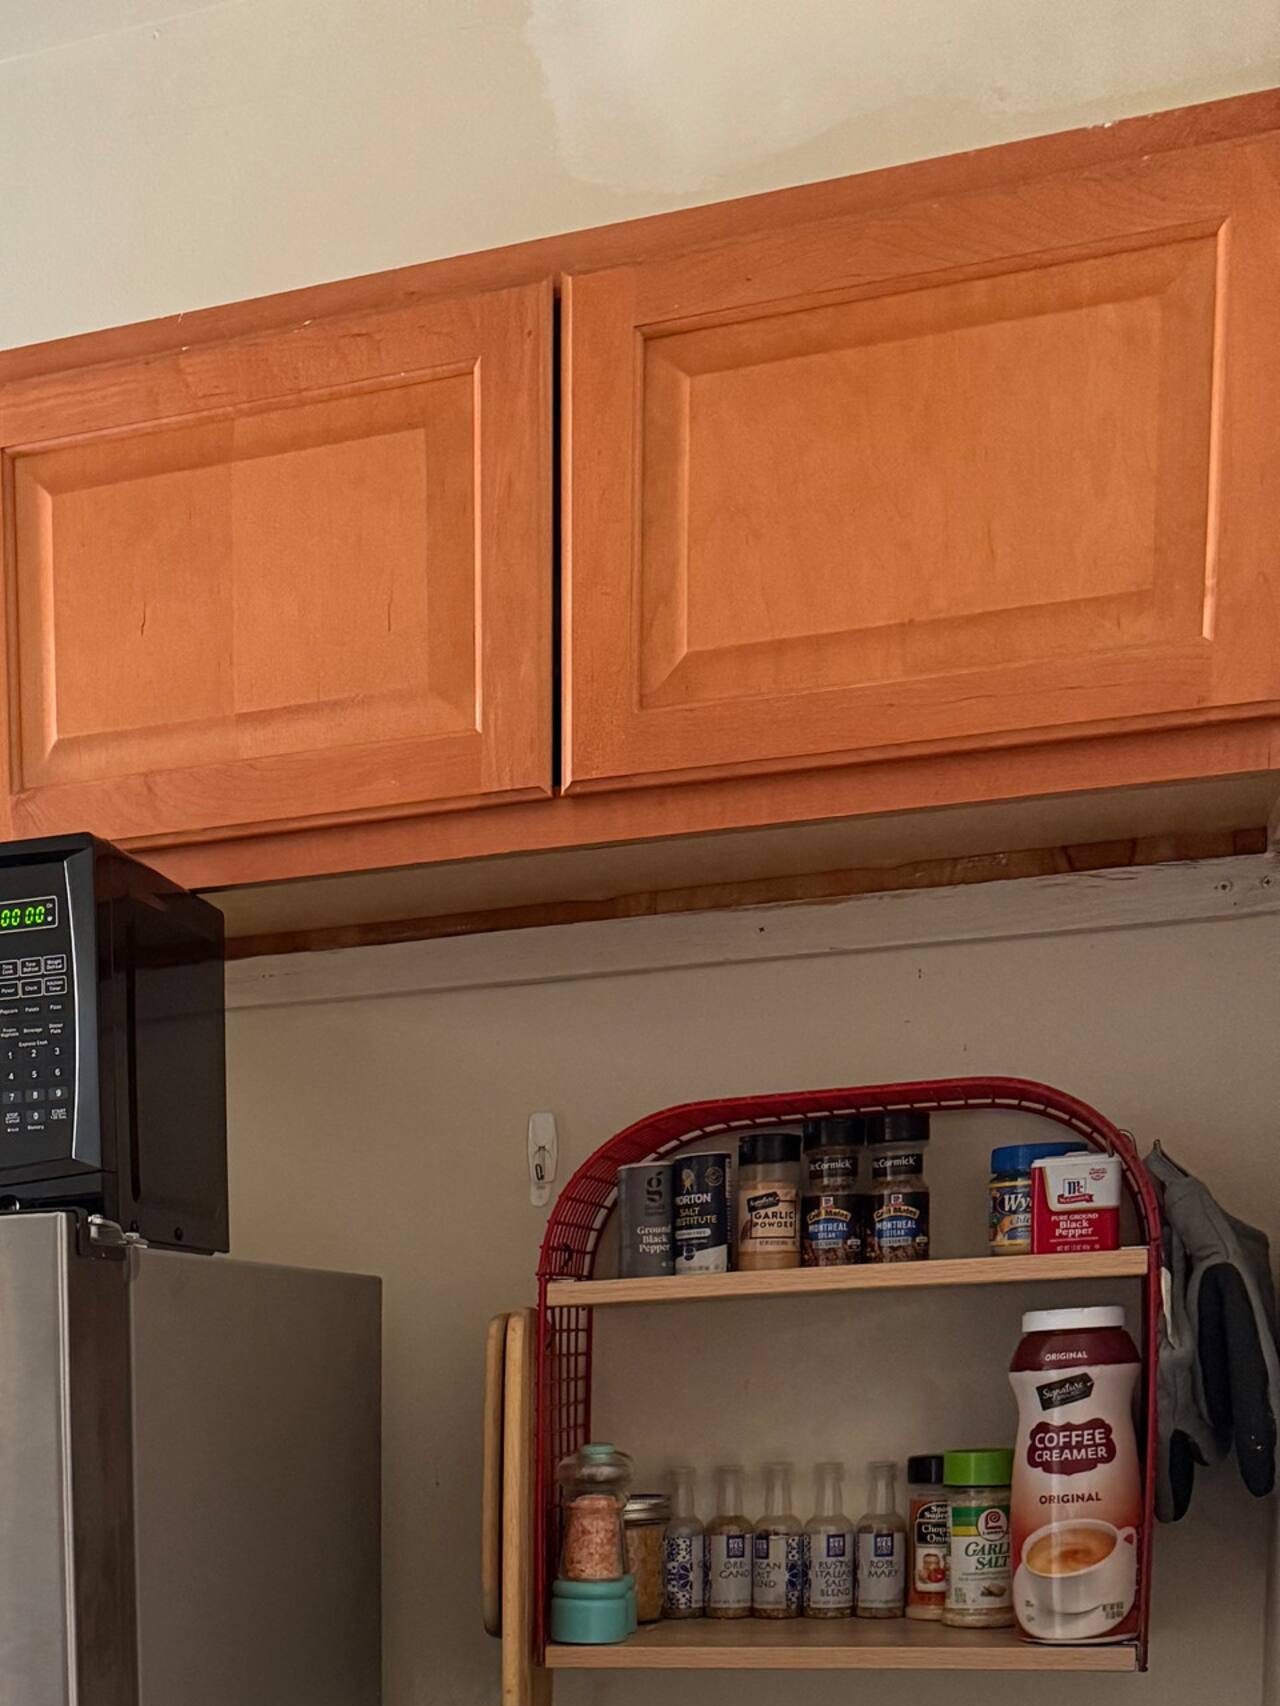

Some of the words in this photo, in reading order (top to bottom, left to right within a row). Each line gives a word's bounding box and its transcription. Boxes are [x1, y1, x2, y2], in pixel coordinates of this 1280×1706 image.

[754, 1210, 794, 1220] GARLIC
[1059, 1219, 1089, 1229] Black
[1055, 1227, 1094, 1237] Pepper
[1044, 1350, 1088, 1361] ORIGINAL
[1035, 1428, 1107, 1448] COFFEE
[1034, 1445, 1108, 1462] CREAMER
[1038, 1491, 1102, 1505] ORIGINAL
